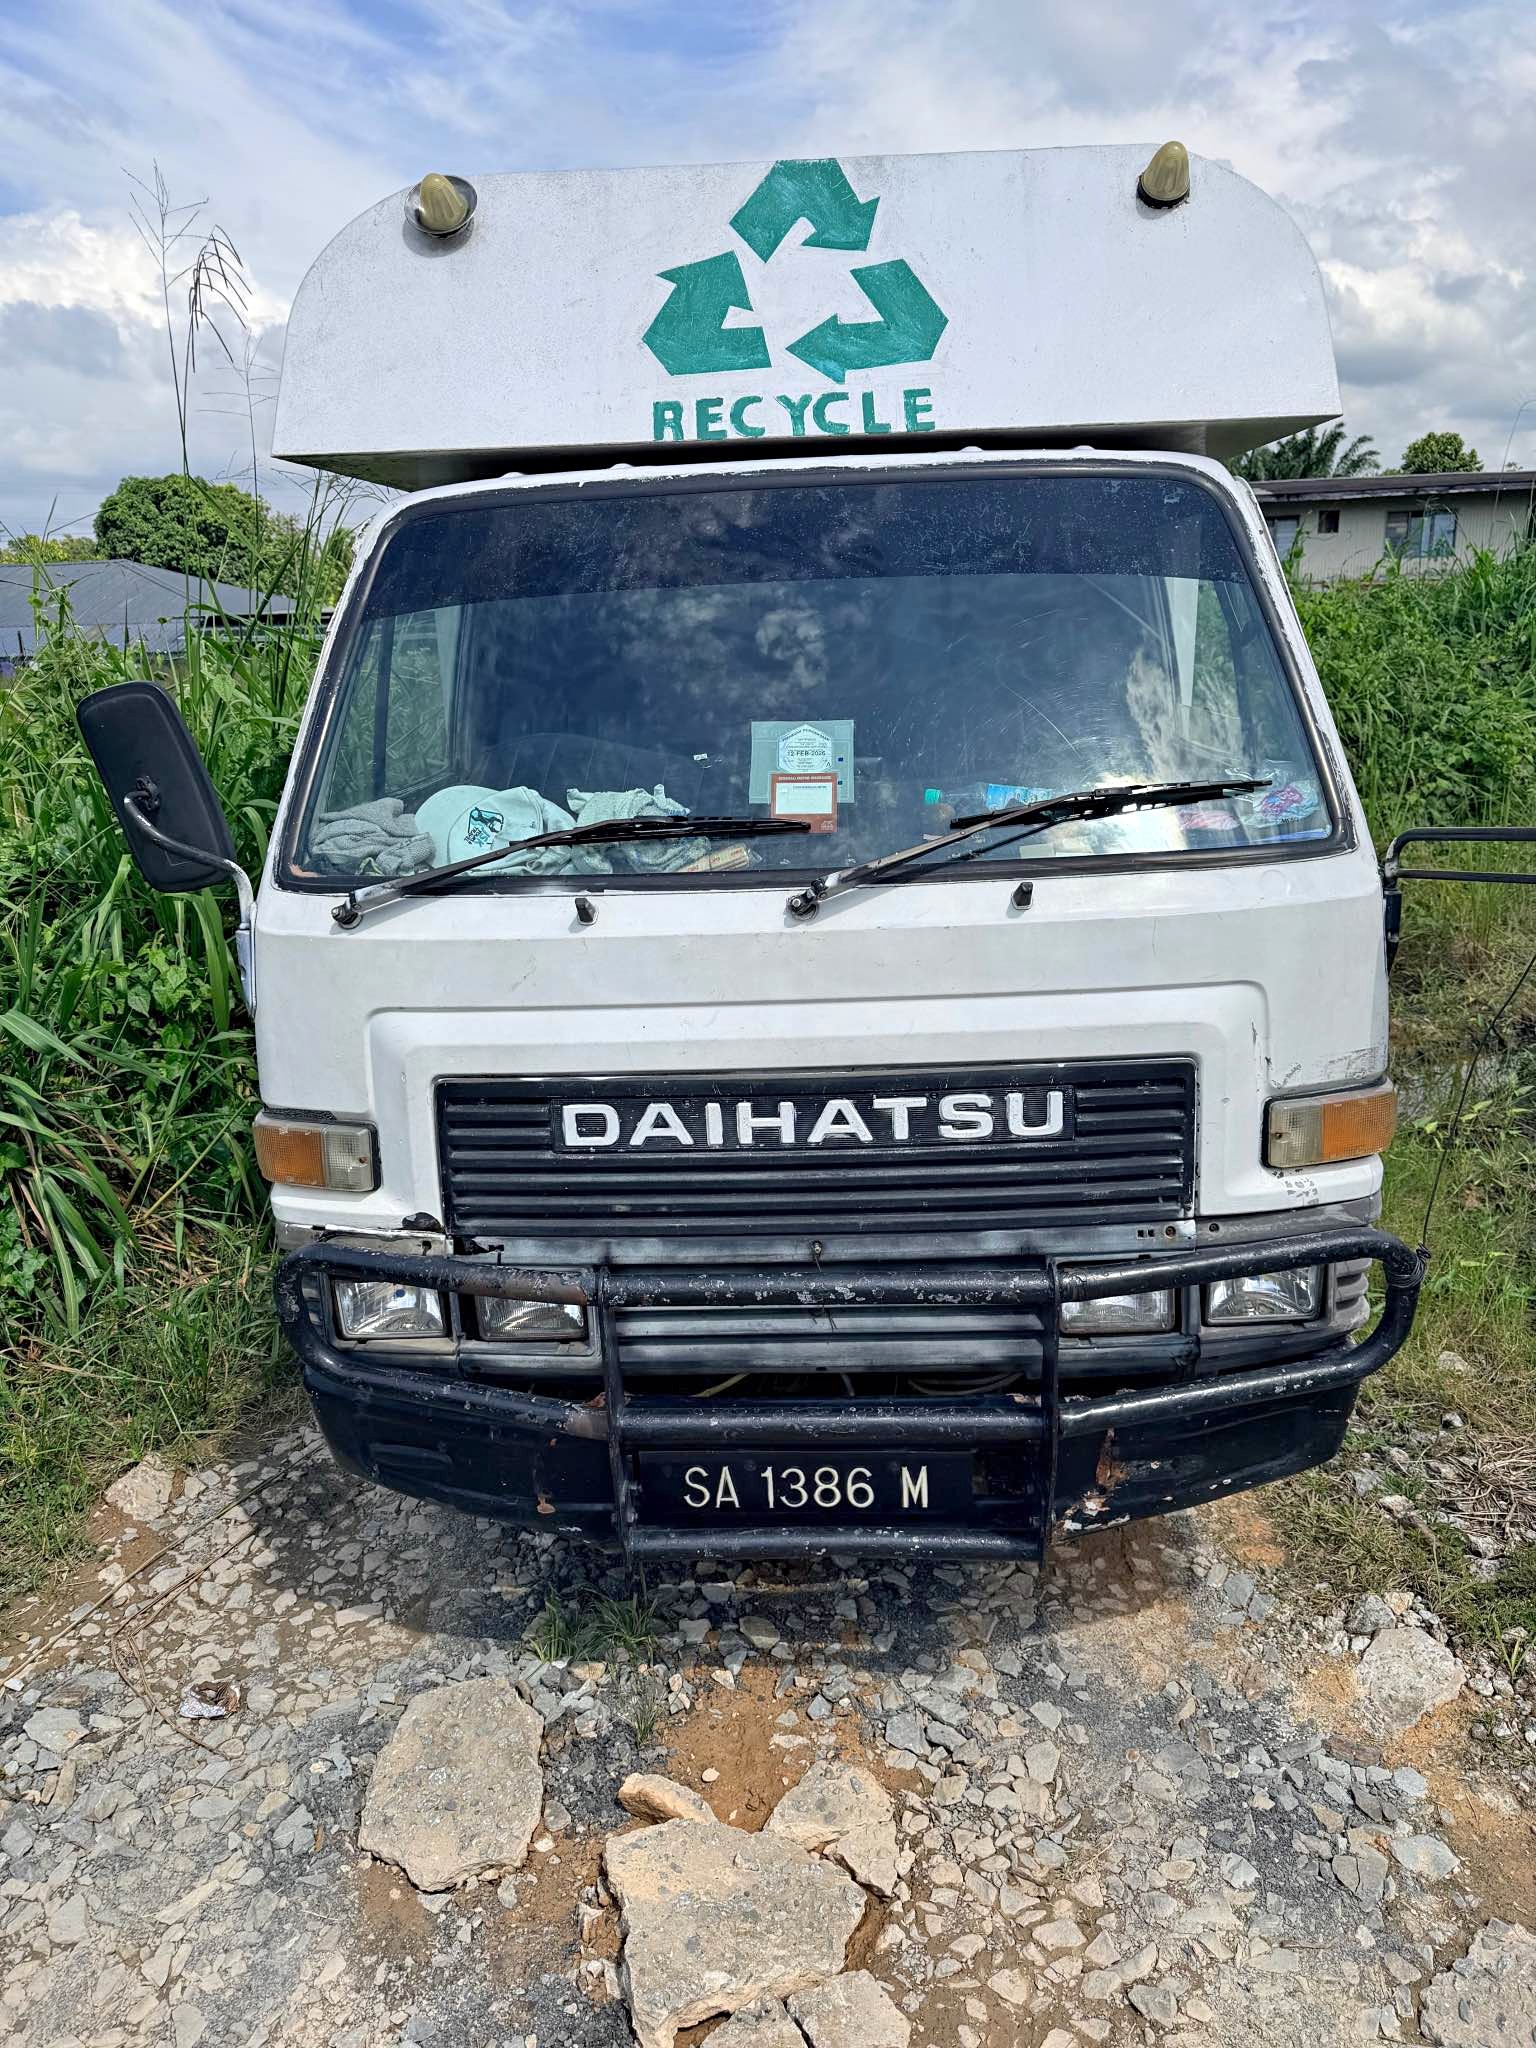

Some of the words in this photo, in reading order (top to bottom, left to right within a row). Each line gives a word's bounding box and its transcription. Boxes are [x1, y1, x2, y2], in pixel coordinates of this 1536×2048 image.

[652, 388, 935, 441] RECYCLE
[562, 1090, 1064, 1146] DAIHATSU
[683, 1465, 740, 1508] SA
[760, 1465, 875, 1508] 1386
[901, 1465, 928, 1508] M
